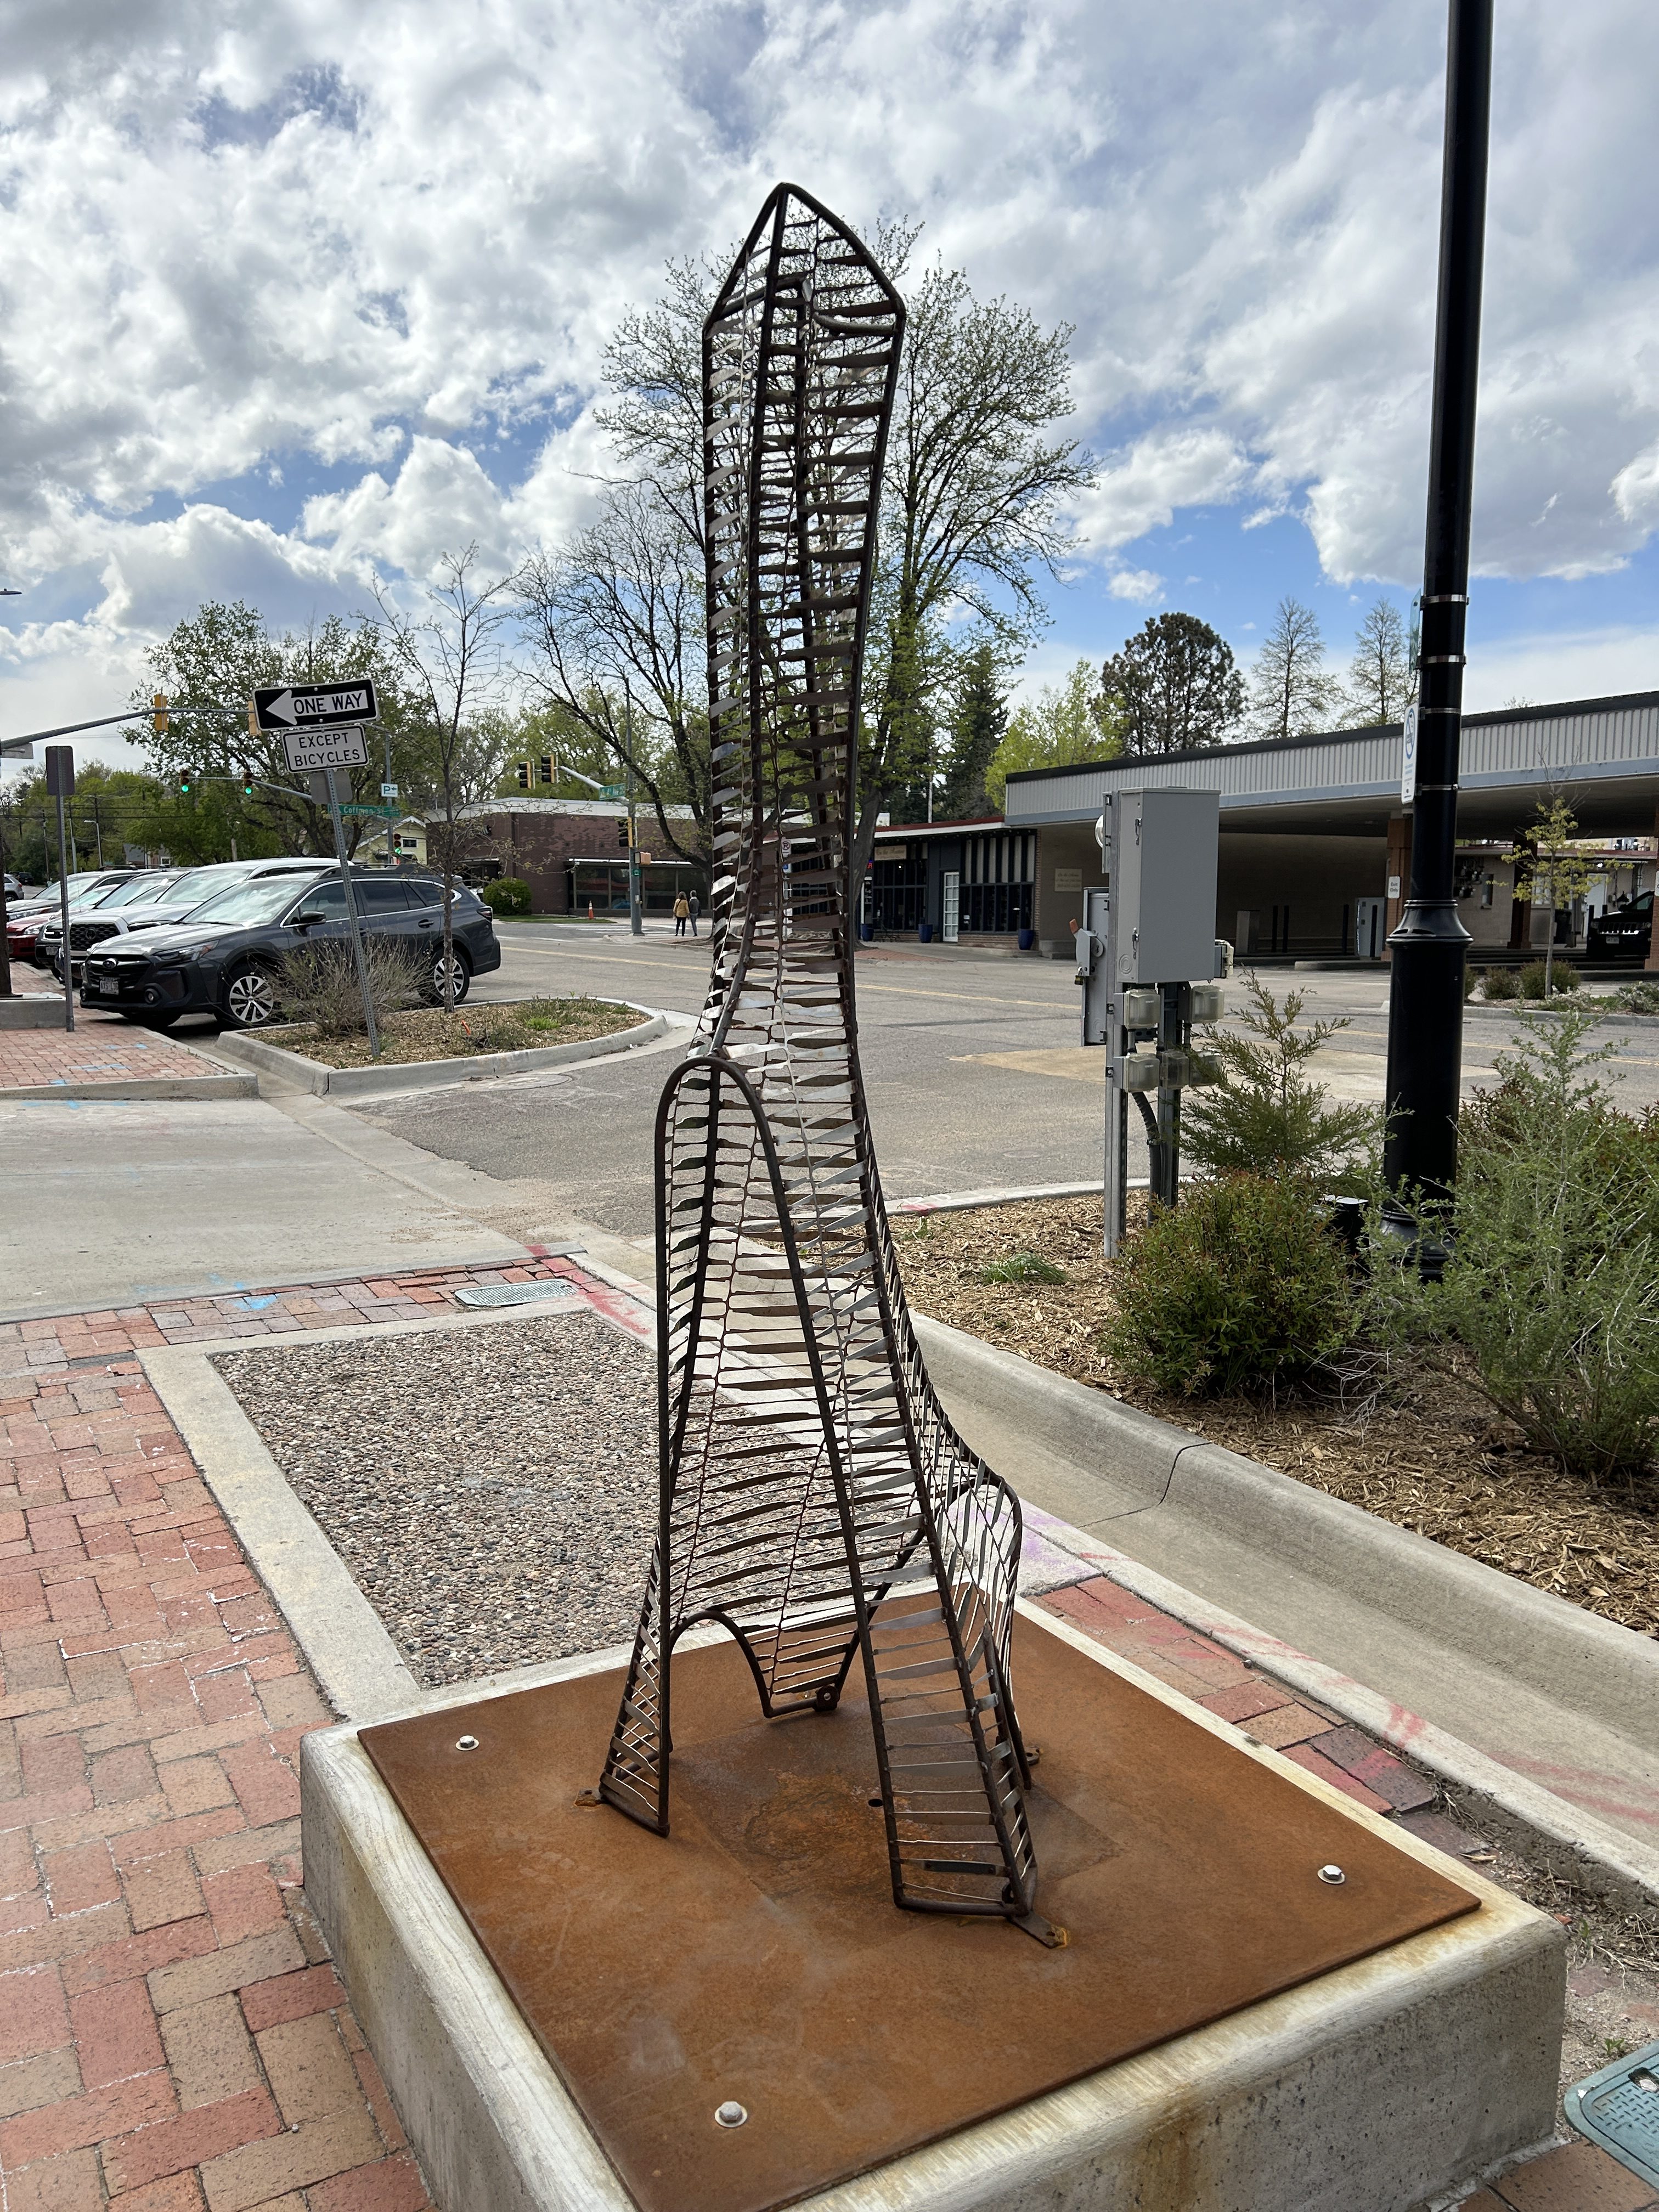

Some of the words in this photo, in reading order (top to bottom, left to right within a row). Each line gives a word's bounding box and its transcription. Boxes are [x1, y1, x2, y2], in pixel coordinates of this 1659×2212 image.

[294, 698, 326, 714] ONE
[332, 692, 362, 710] WAY
[298, 732, 348, 748] EXCEPT
[294, 749, 360, 766] BICYCLES
